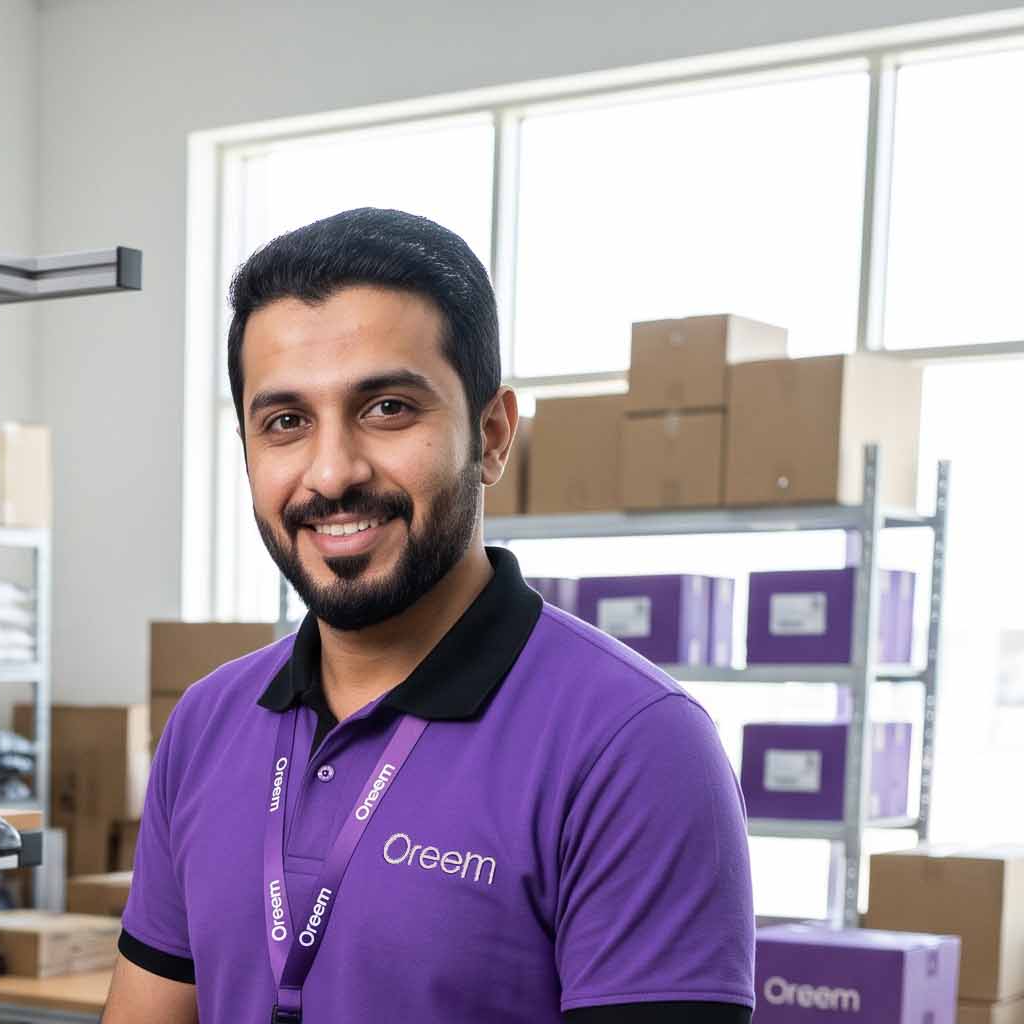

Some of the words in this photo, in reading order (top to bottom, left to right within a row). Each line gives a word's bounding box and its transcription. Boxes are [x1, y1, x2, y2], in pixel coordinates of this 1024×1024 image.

[269, 757, 288, 812] Oreem
[355, 764, 396, 821] Oreem
[383, 832, 497, 885] Oreem
[269, 879, 287, 941] Oreem
[299, 887, 332, 947] Oreem
[764, 976, 861, 1012] Oreem
